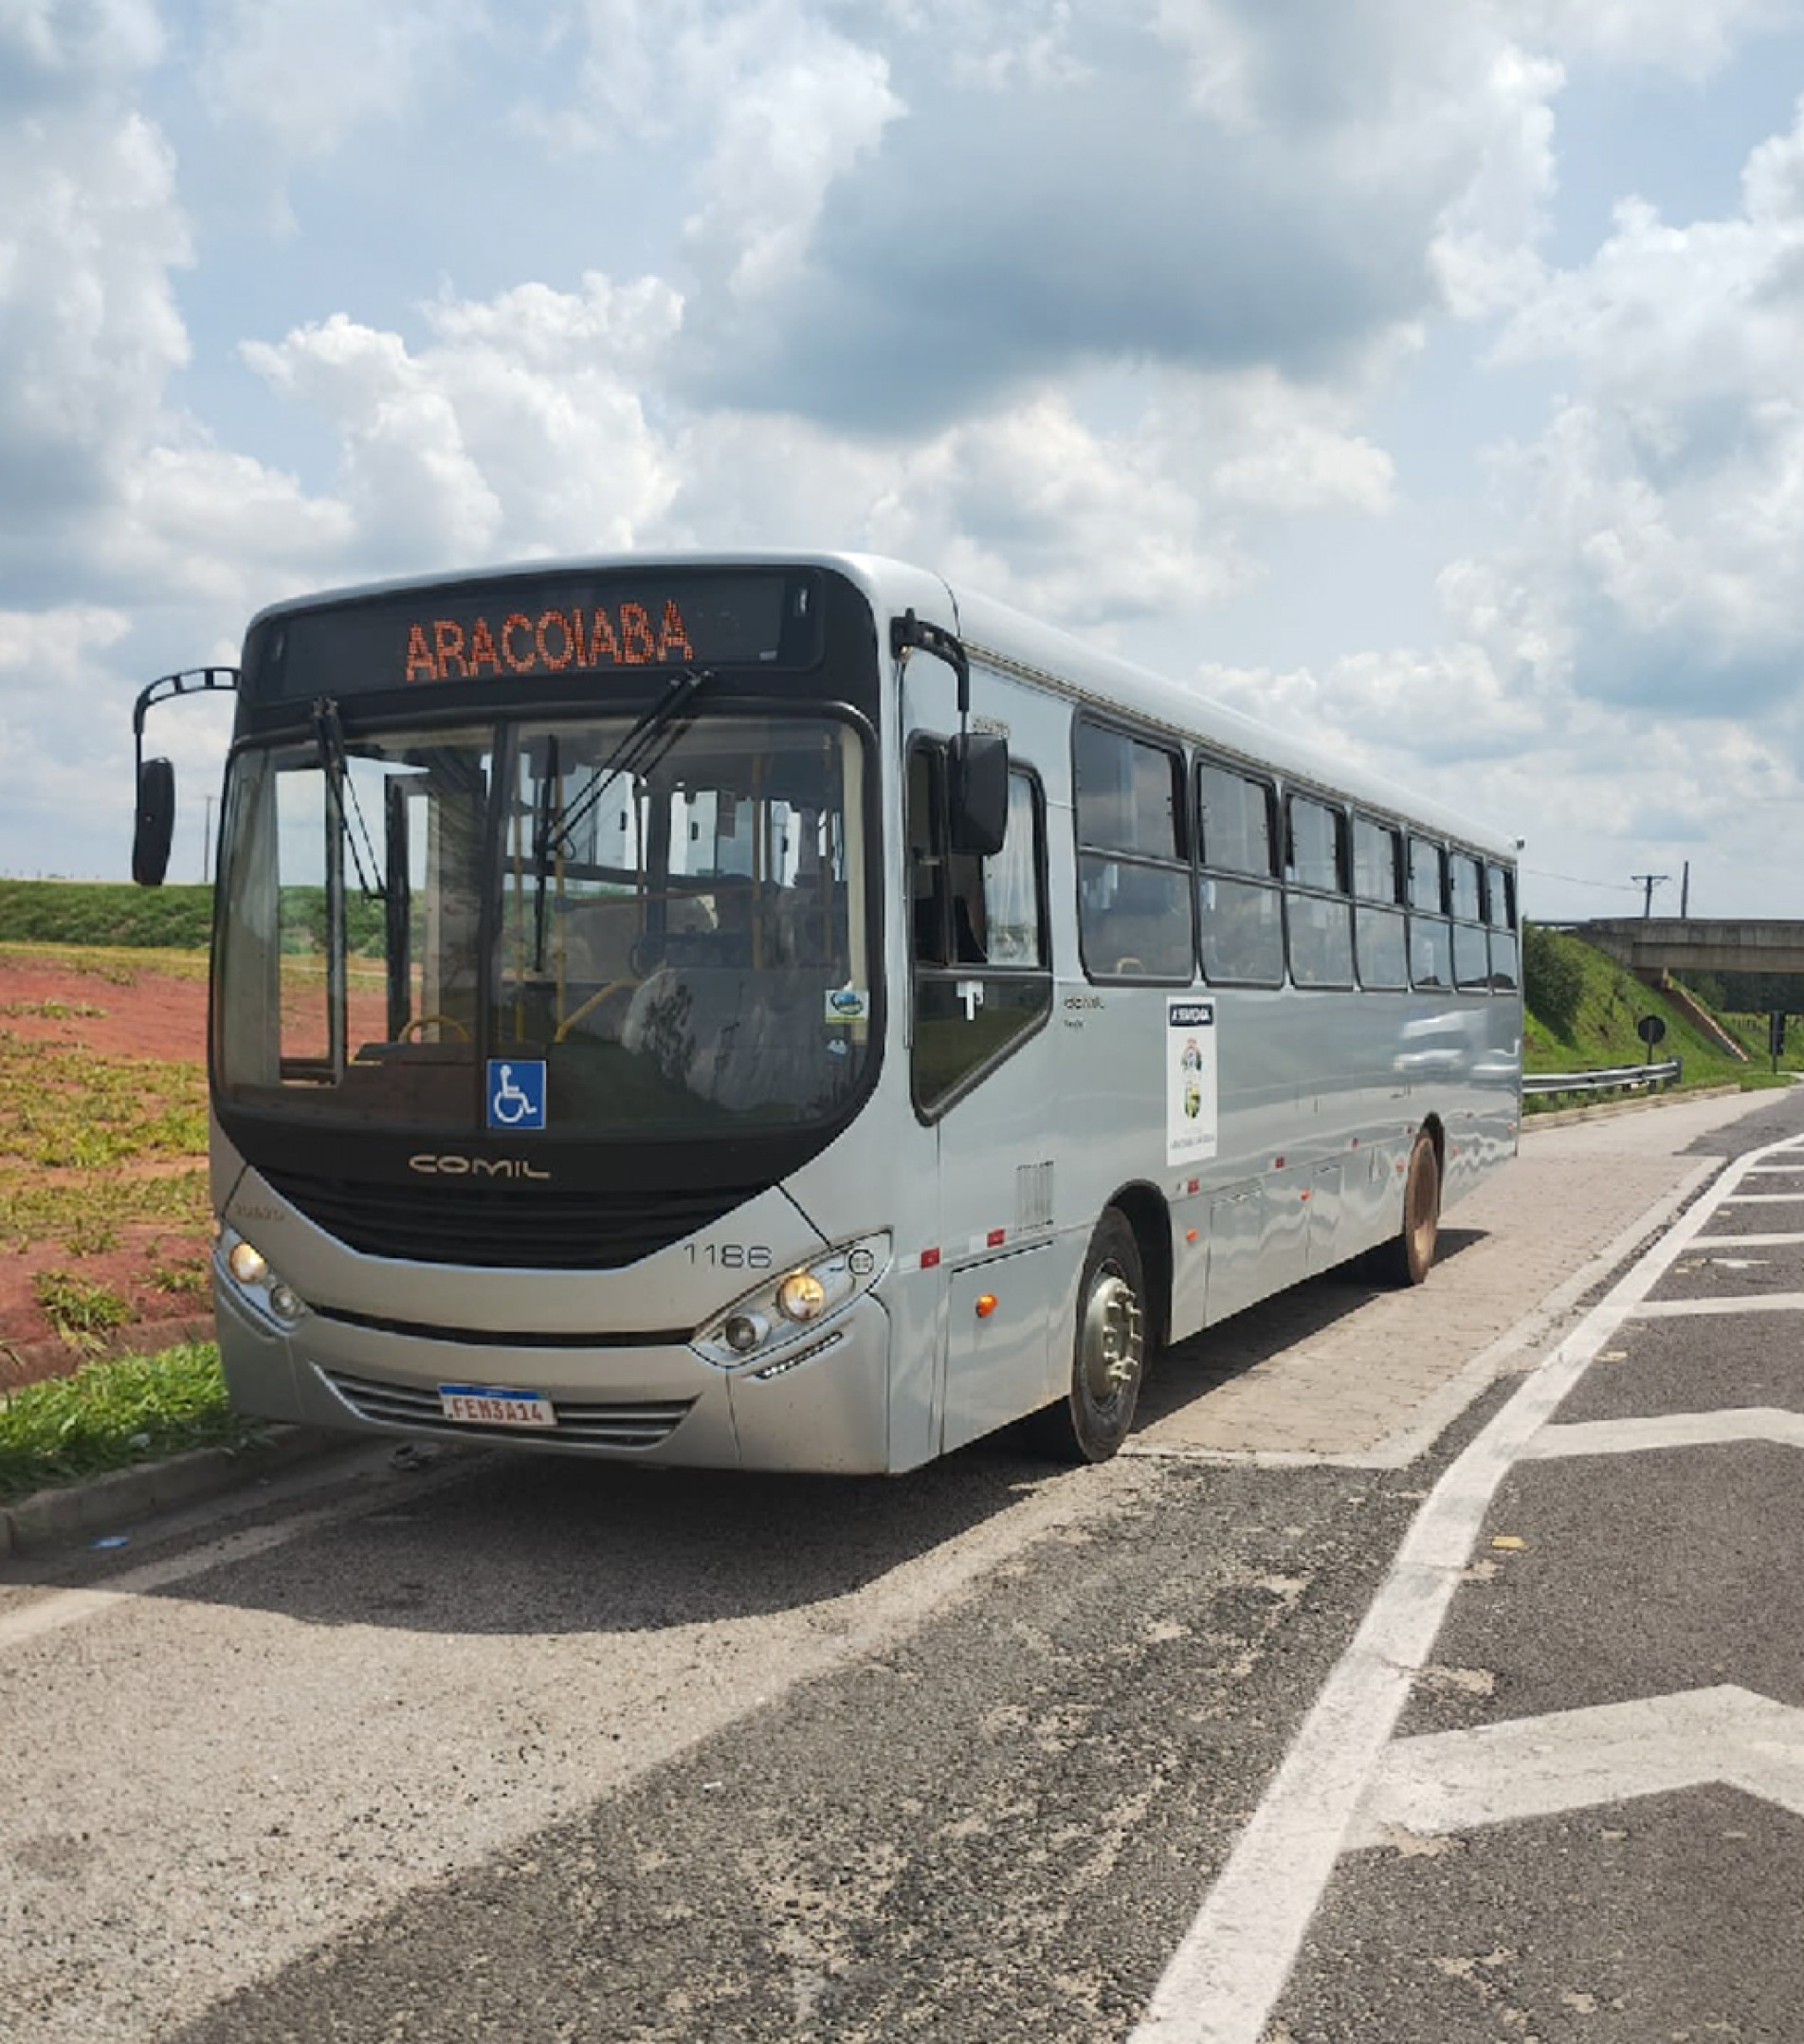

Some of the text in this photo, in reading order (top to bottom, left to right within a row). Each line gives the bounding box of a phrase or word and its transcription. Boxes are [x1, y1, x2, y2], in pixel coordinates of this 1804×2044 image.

[406, 599, 694, 682] ARACOIABA
[409, 1154, 551, 1180] COMIL
[683, 1243, 773, 1268] 1186
